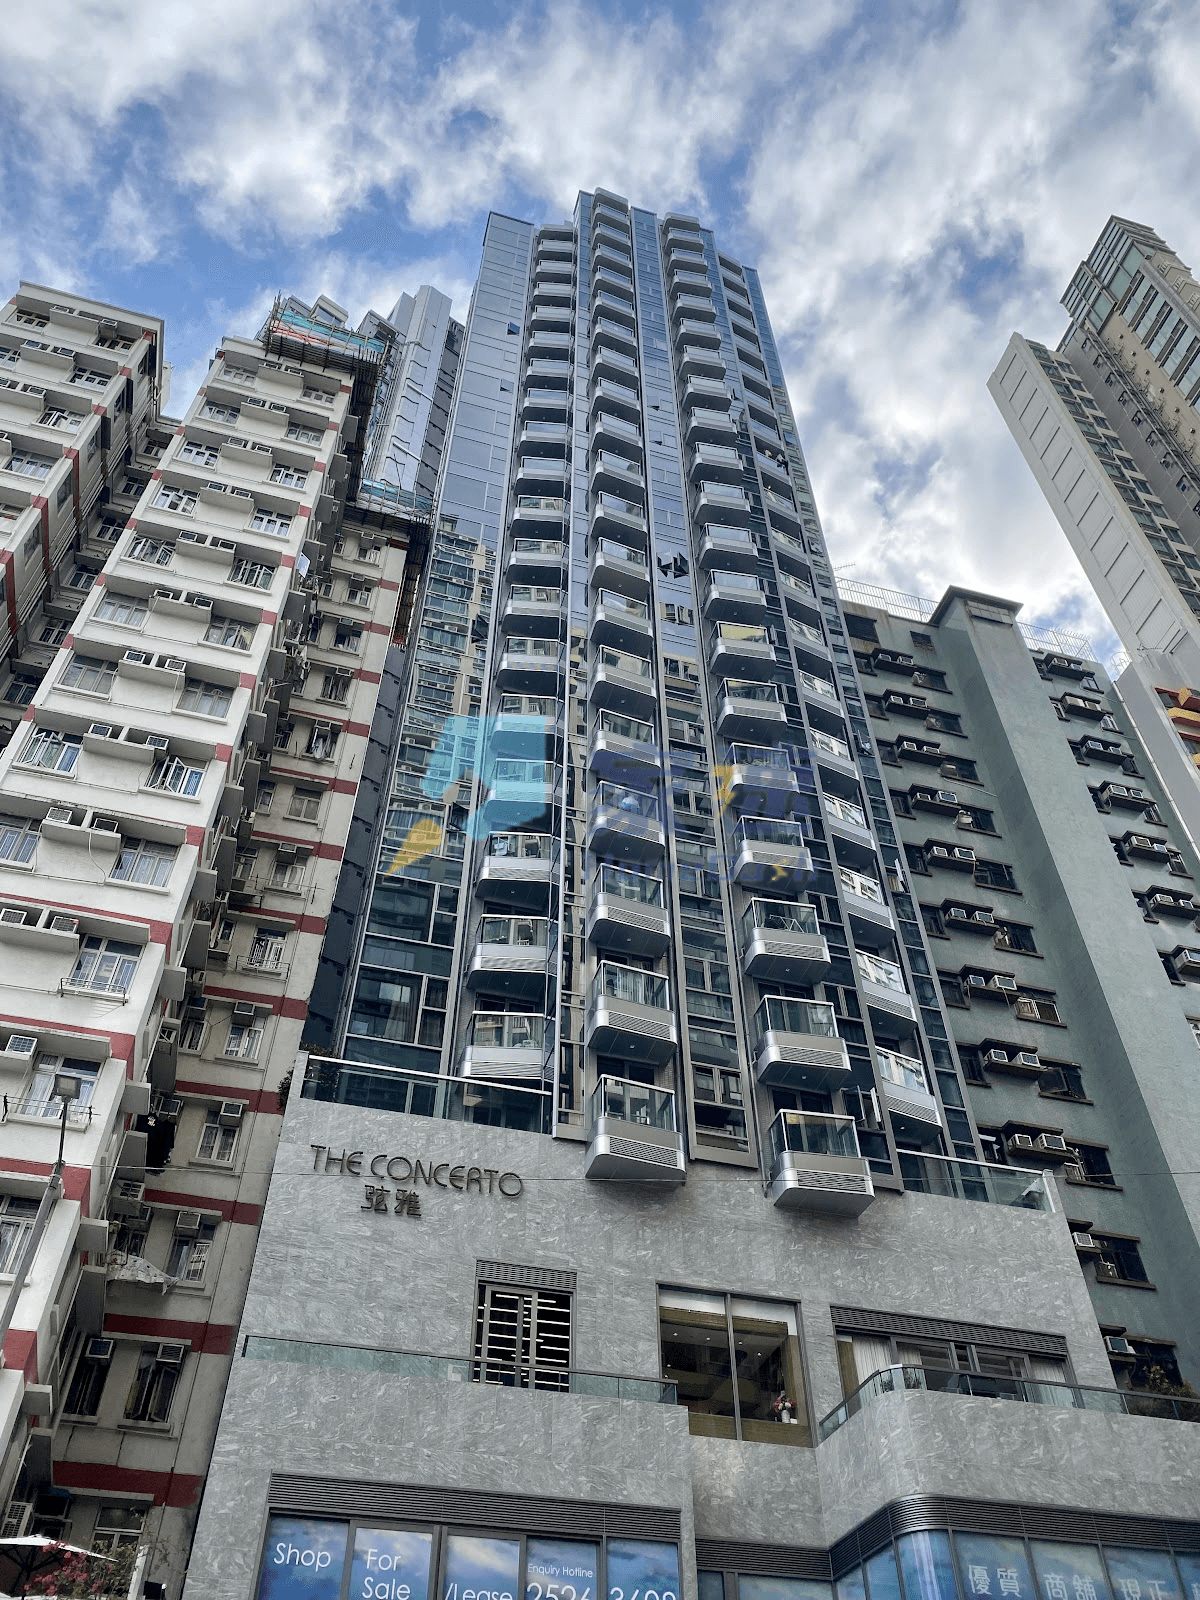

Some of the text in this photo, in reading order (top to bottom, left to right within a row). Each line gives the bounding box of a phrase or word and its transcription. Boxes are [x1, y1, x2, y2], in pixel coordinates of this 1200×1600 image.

[310, 1143, 524, 1198] THE CONCERTO
[361, 1184, 422, 1218] 弦雅
[273, 1542, 332, 1572] Shop
[366, 1548, 402, 1571] For
[527, 1563, 594, 1578] Enquiry Hotline
[361, 1576, 411, 1600] Sale
[968, 1564, 1023, 1598] 優質
